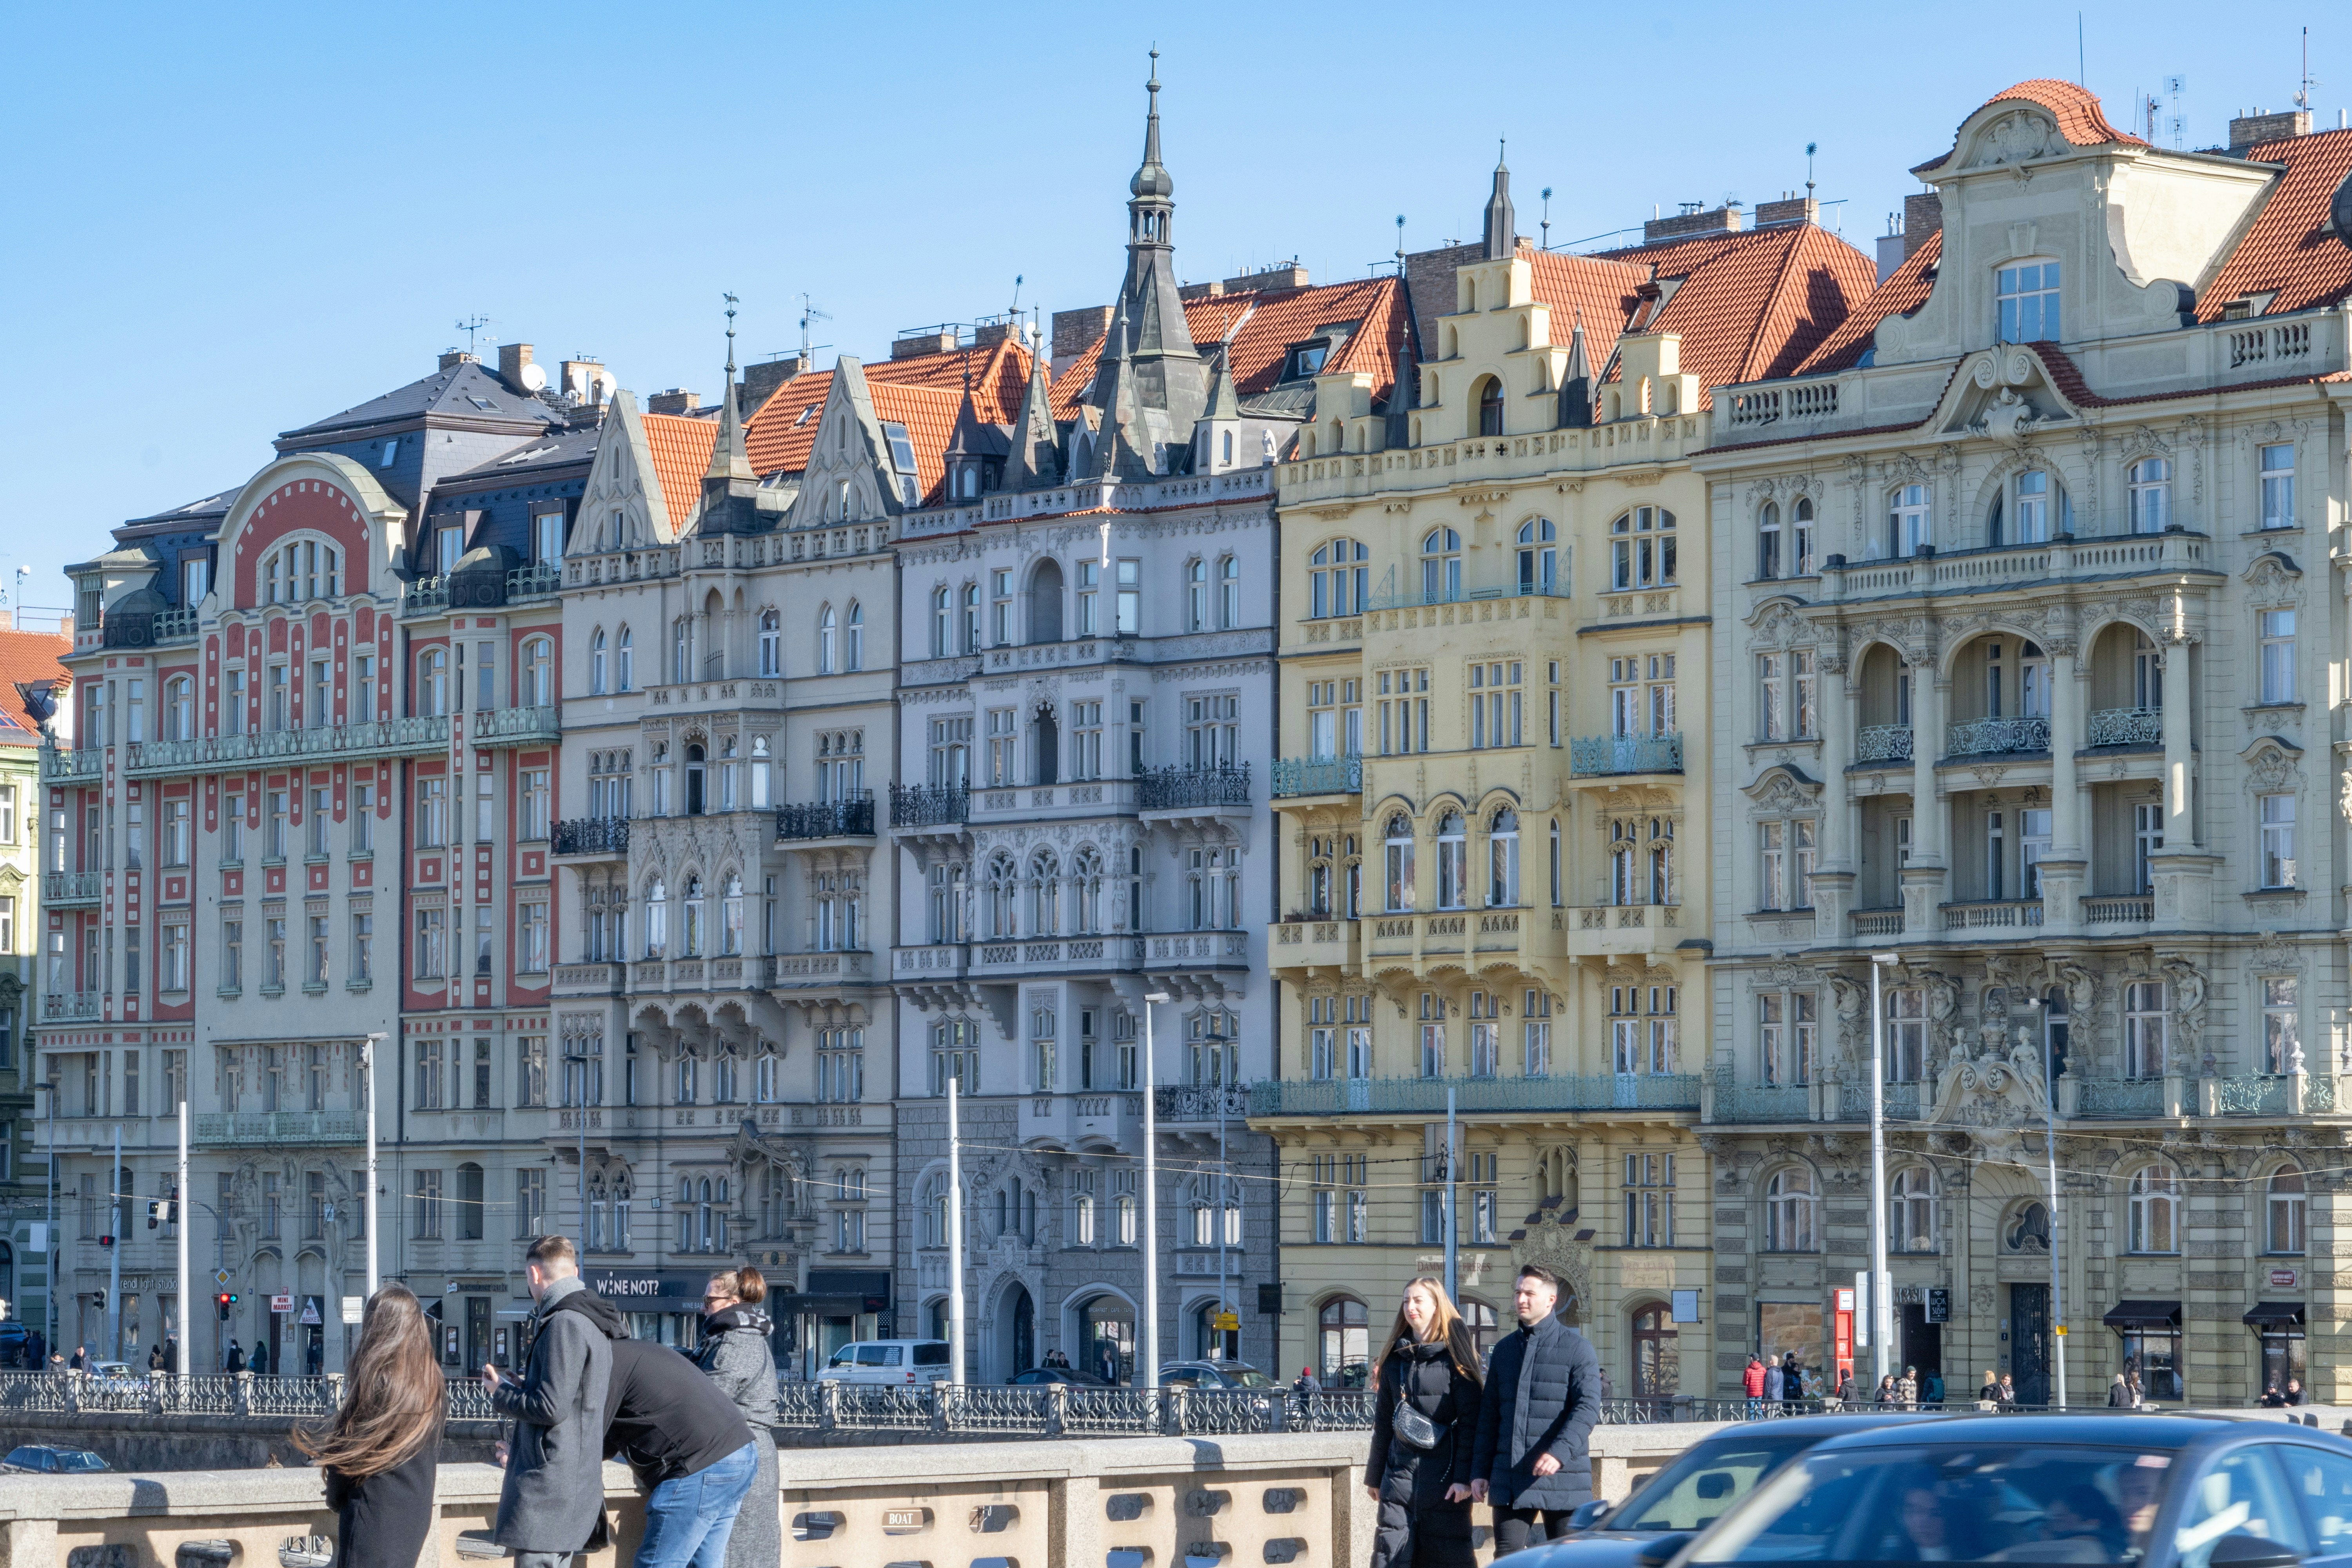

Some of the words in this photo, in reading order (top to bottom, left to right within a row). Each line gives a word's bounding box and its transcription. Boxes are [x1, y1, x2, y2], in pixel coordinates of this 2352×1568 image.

[1417, 1261, 1445, 1271] DAMM
[120, 1277, 137, 1289] rendl
[141, 1277, 154, 1292] light
[158, 1278, 177, 1289] studio
[631, 1280, 659, 1295] NOT?
[889, 1513, 913, 1524] BOAT
